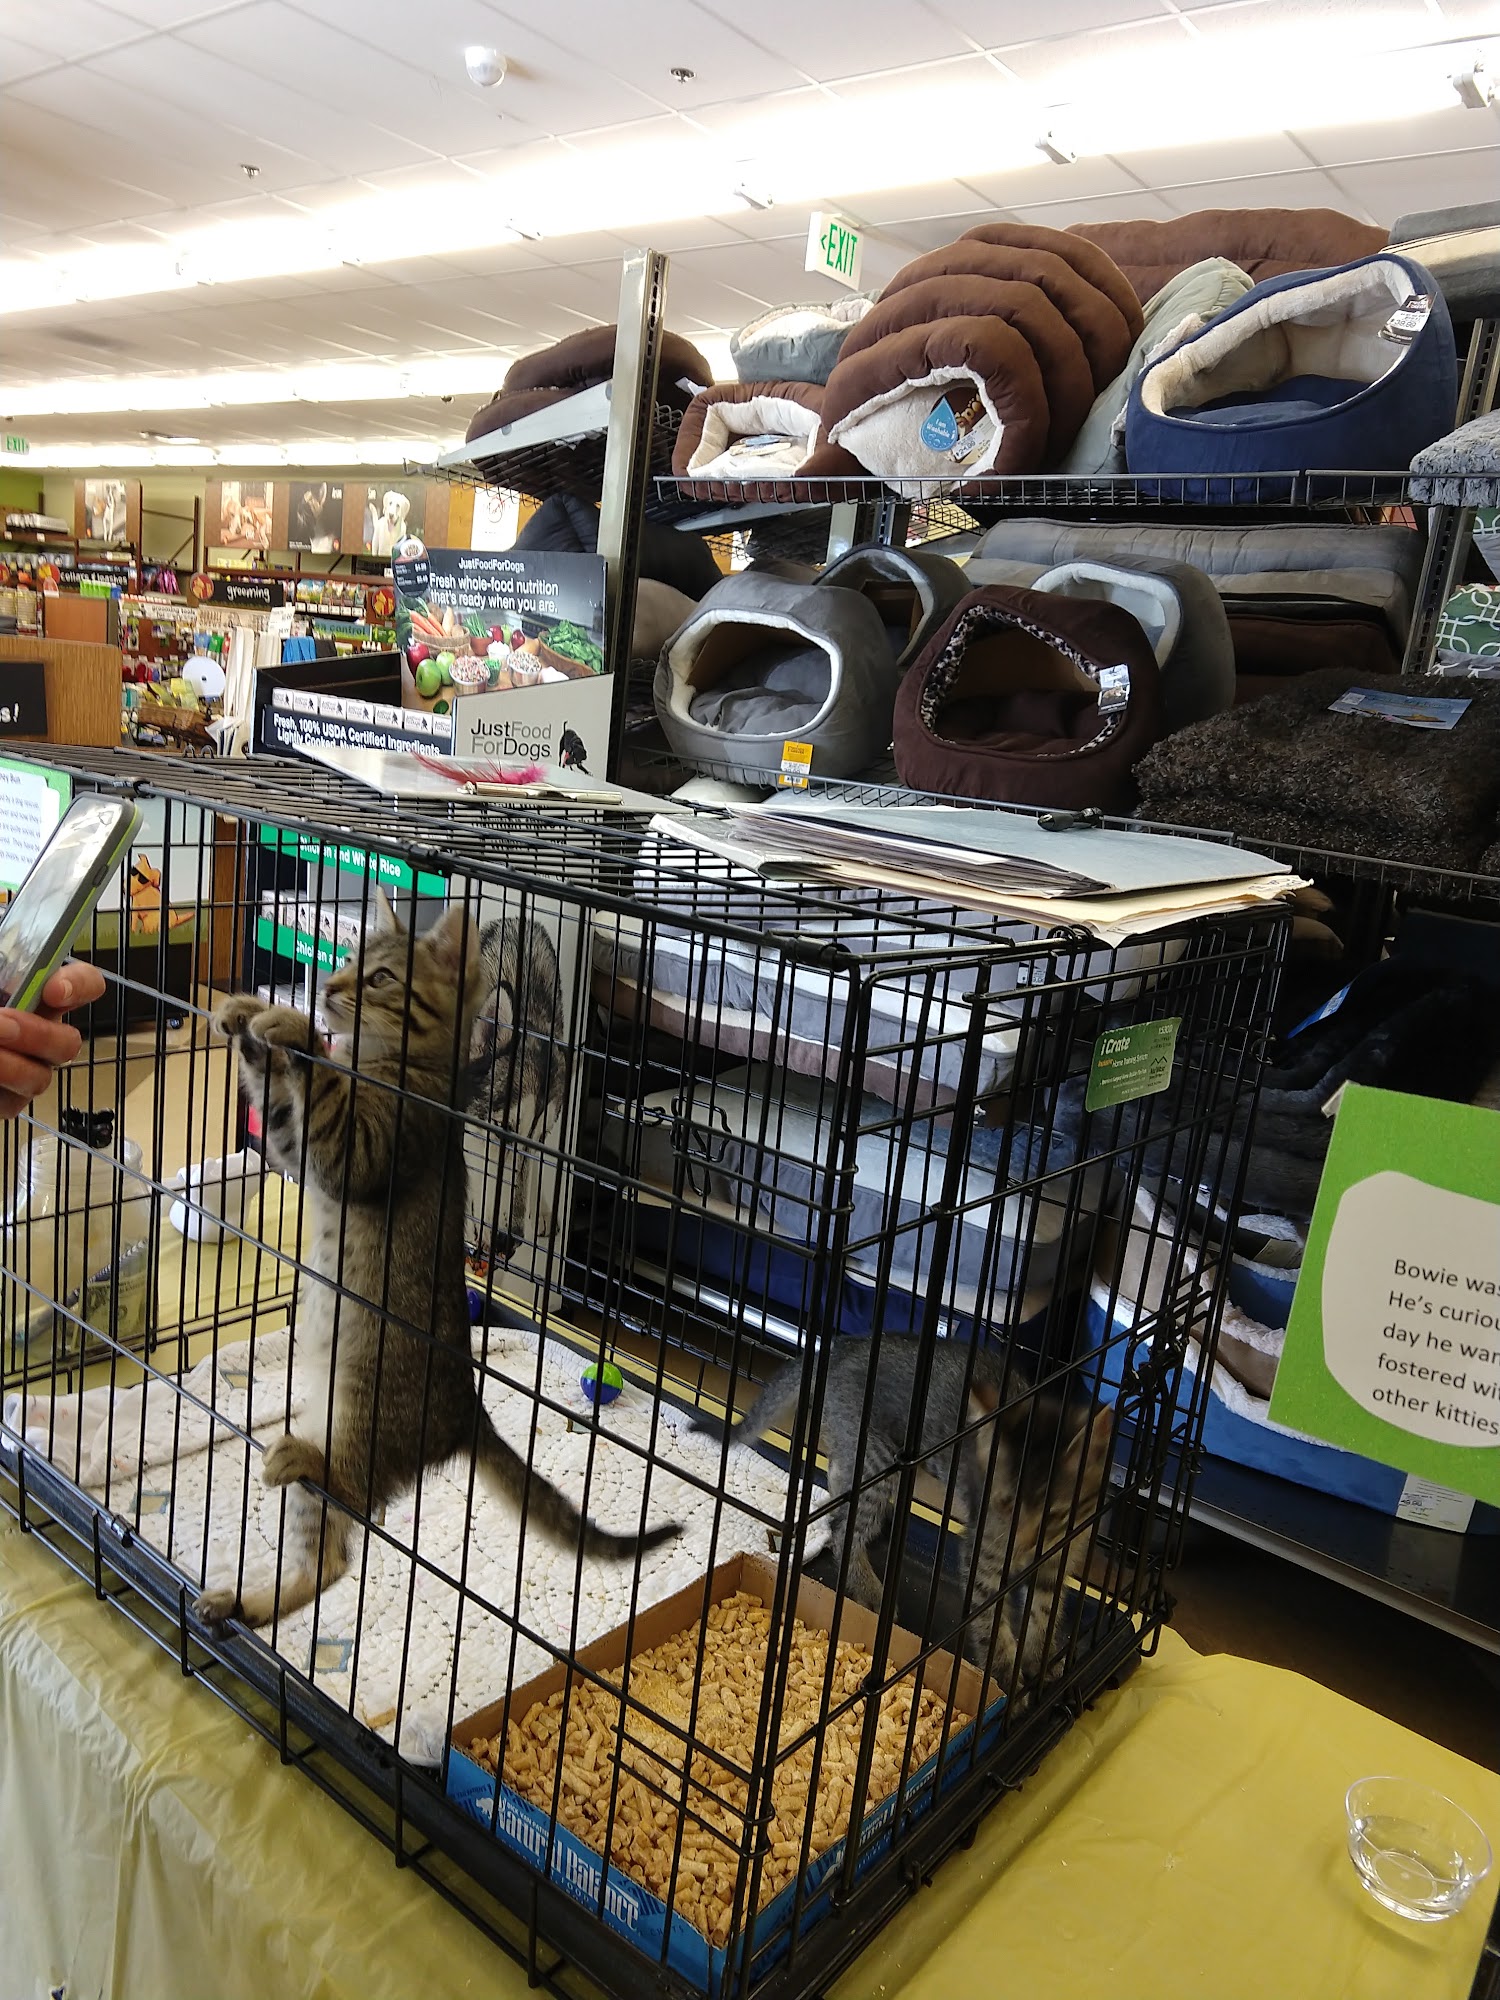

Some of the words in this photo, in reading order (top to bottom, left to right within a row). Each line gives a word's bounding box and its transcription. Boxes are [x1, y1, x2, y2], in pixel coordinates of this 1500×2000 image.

[826, 222, 858, 277] EXIT
[926, 423, 950, 438] Washable
[6, 435, 25, 454] EXIT
[458, 556, 524, 573] JustFoodForDogs
[226, 584, 271, 604] grooming
[430, 572, 456, 590] Fresh
[458, 575, 514, 594] whole-food
[516, 578, 559, 596] nutrition
[430, 588, 457, 606] that's
[458, 591, 486, 610] ready
[488, 594, 515, 609] when
[517, 600, 536, 613] you
[538, 600, 558, 614] are.
[330, 623, 366, 635] control
[0, 703, 20, 723] s!
[277, 727, 304, 746] Lightly
[299, 718, 321, 736] 100%
[322, 722, 347, 741] USDA
[348, 727, 386, 748] Certified
[470, 718, 552, 739] JustFood
[472, 736, 552, 760] ForDogs
[334, 849, 350, 864] and
[352, 850, 377, 870] Whte
[380, 858, 402, 878] Rice
[328, 953, 345, 968] and
[1394, 1258, 1459, 1287] Bowie
[1388, 1290, 1434, 1315] He’s
[1383, 1322, 1420, 1348] day
[1427, 1331, 1452, 1353] he
[1460, 1344, 1500, 1365] wan
[1378, 1352, 1467, 1390] fostered
[1372, 1388, 1430, 1413] other
[1435, 1400, 1500, 1435] kitties
[506, 1802, 519, 1814] DICK
[520, 1812, 532, 1825] VAN
[566, 1846, 640, 1930] Balance
